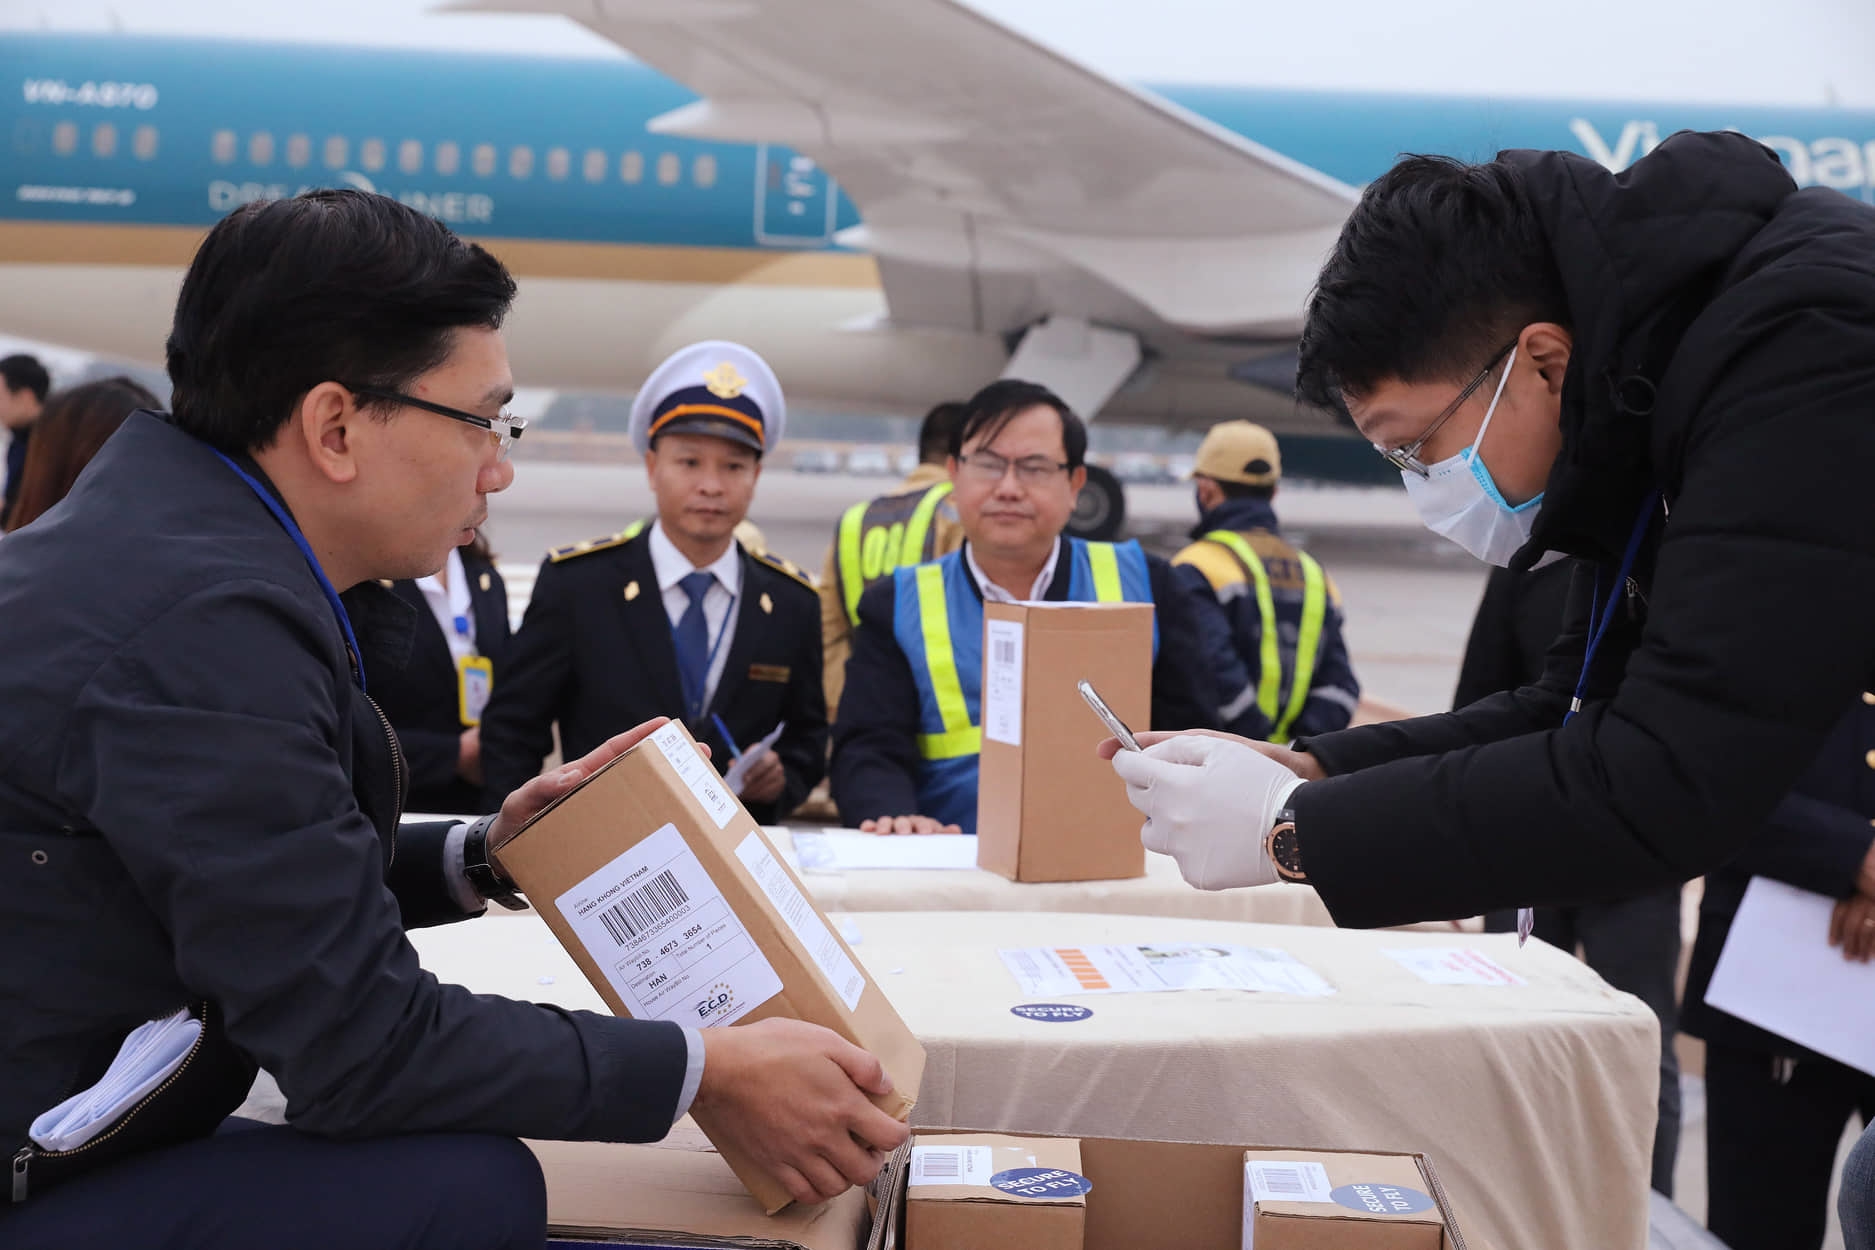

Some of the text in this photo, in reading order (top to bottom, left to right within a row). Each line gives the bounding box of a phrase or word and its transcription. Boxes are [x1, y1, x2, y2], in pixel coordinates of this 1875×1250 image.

[578, 866, 649, 916] HANG KHONG VIETNAM
[636, 958, 652, 971] 738
[660, 940, 679, 956] 4673
[683, 924, 702, 940] 3654
[648, 973, 668, 989] HAN
[698, 993, 728, 1018] E.C.D
[998, 1169, 1069, 1190] SECURE
[1017, 1177, 1080, 1196] TO FLY
[1352, 1185, 1387, 1213] SECURE
[1378, 1186, 1414, 1211] TO FLY
